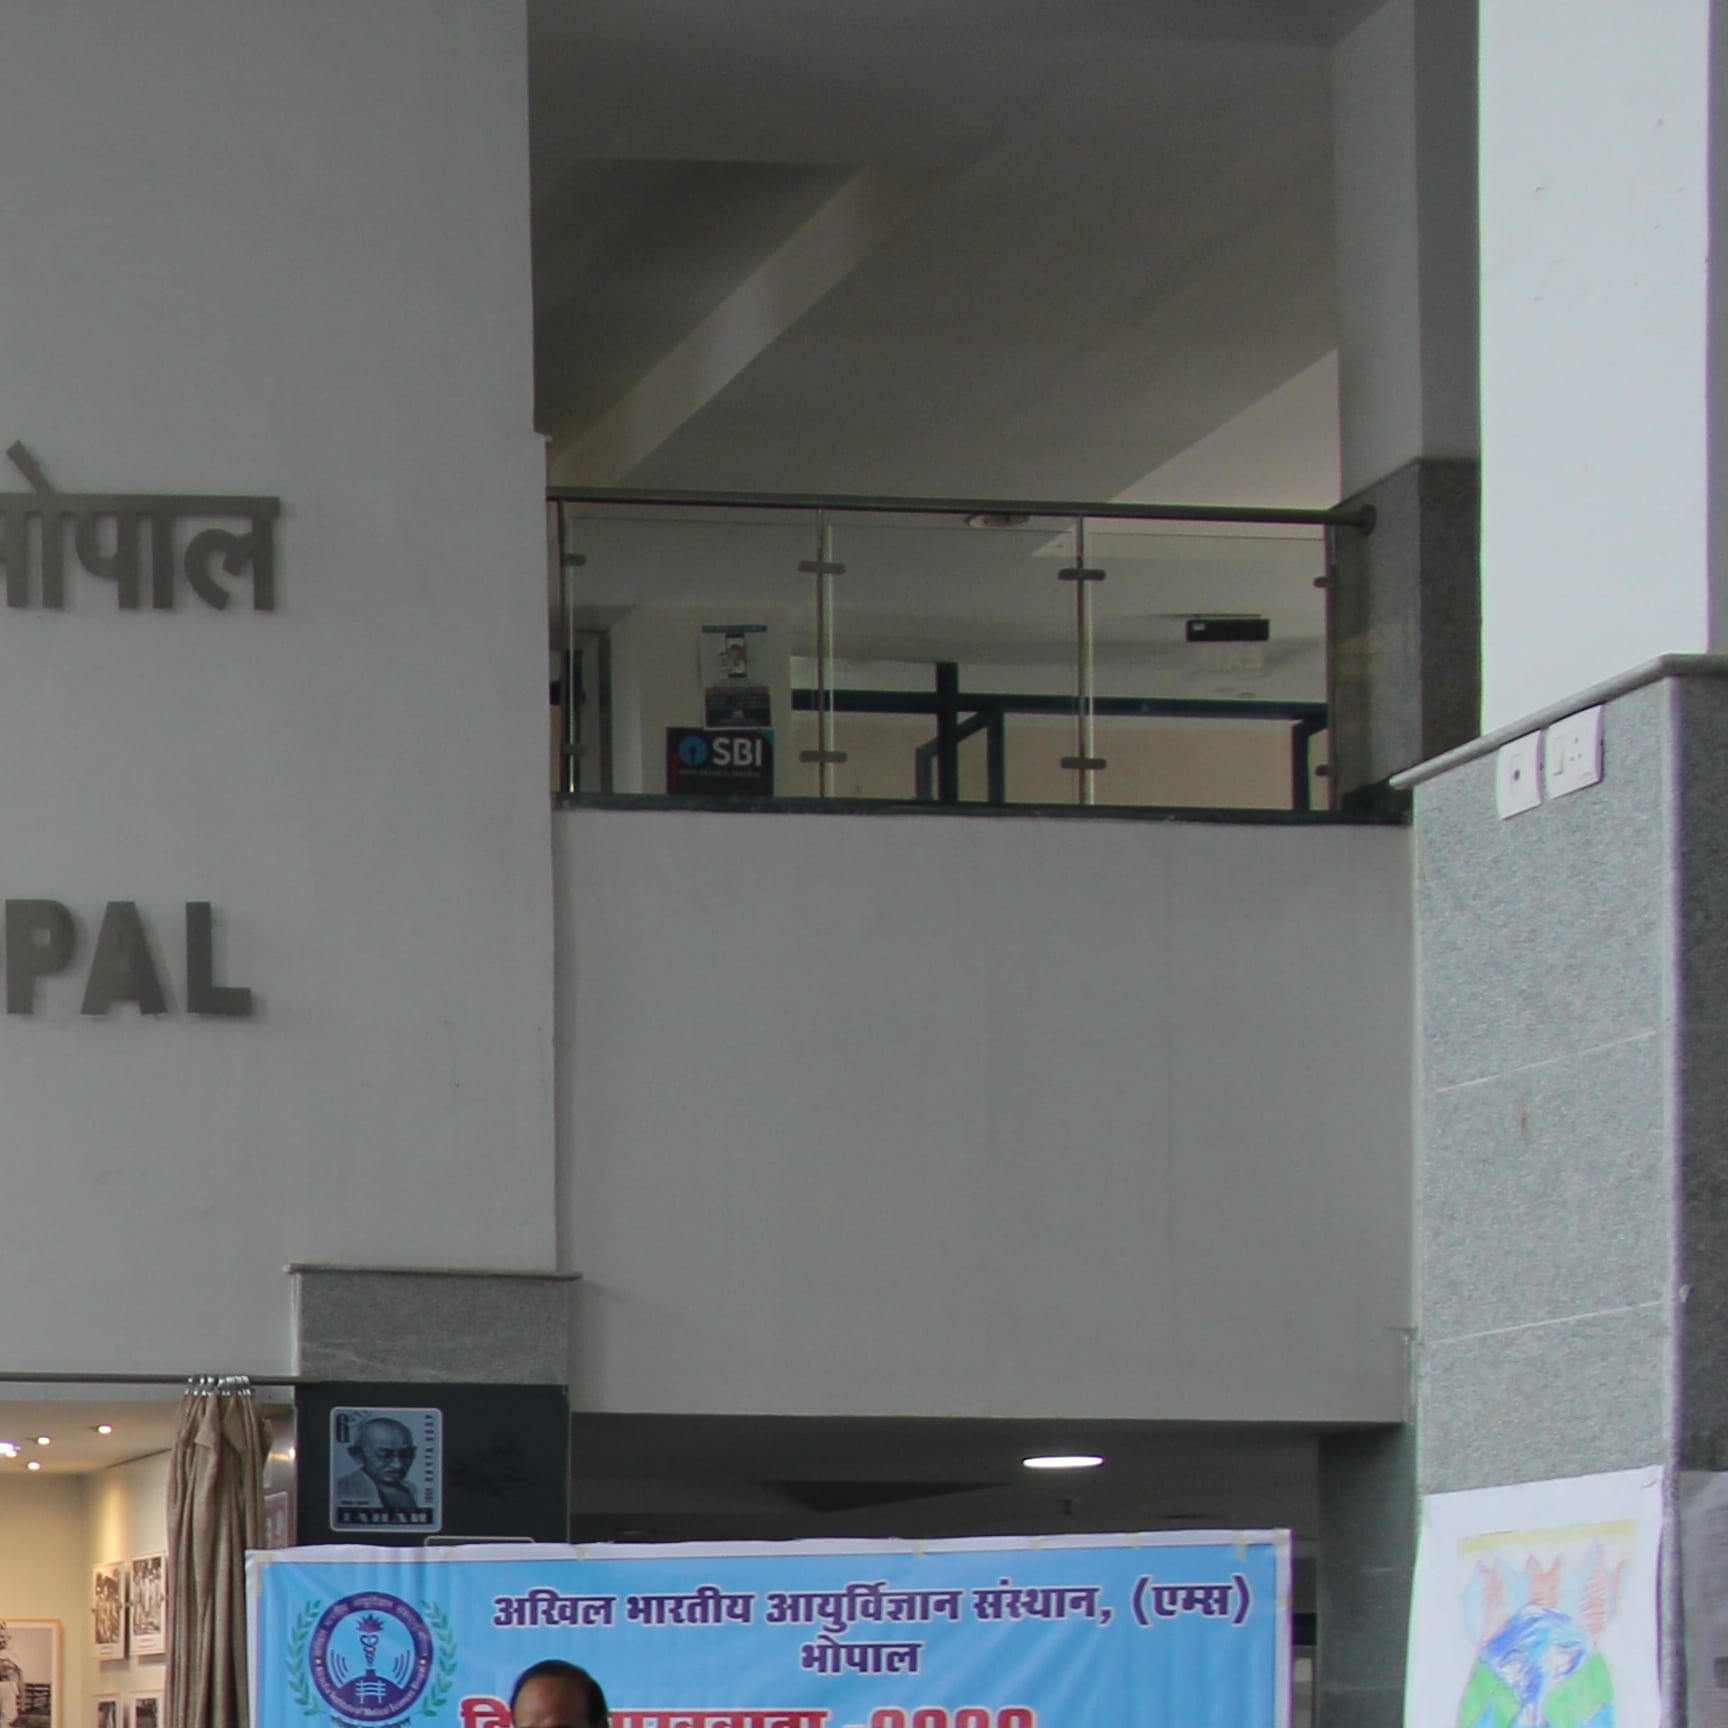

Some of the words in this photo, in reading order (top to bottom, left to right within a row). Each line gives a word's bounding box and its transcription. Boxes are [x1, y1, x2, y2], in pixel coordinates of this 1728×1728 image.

[712, 736, 763, 767] SBI
[494, 1588, 617, 1627] अखिल
[626, 1585, 755, 1624] भारतीय
[765, 1583, 961, 1633] आयुर्विज्ञान
[973, 1579, 1113, 1626] संस्थान,
[1132, 1575, 1251, 1627] (एम्स)
[801, 1634, 922, 1673] भोपाल
